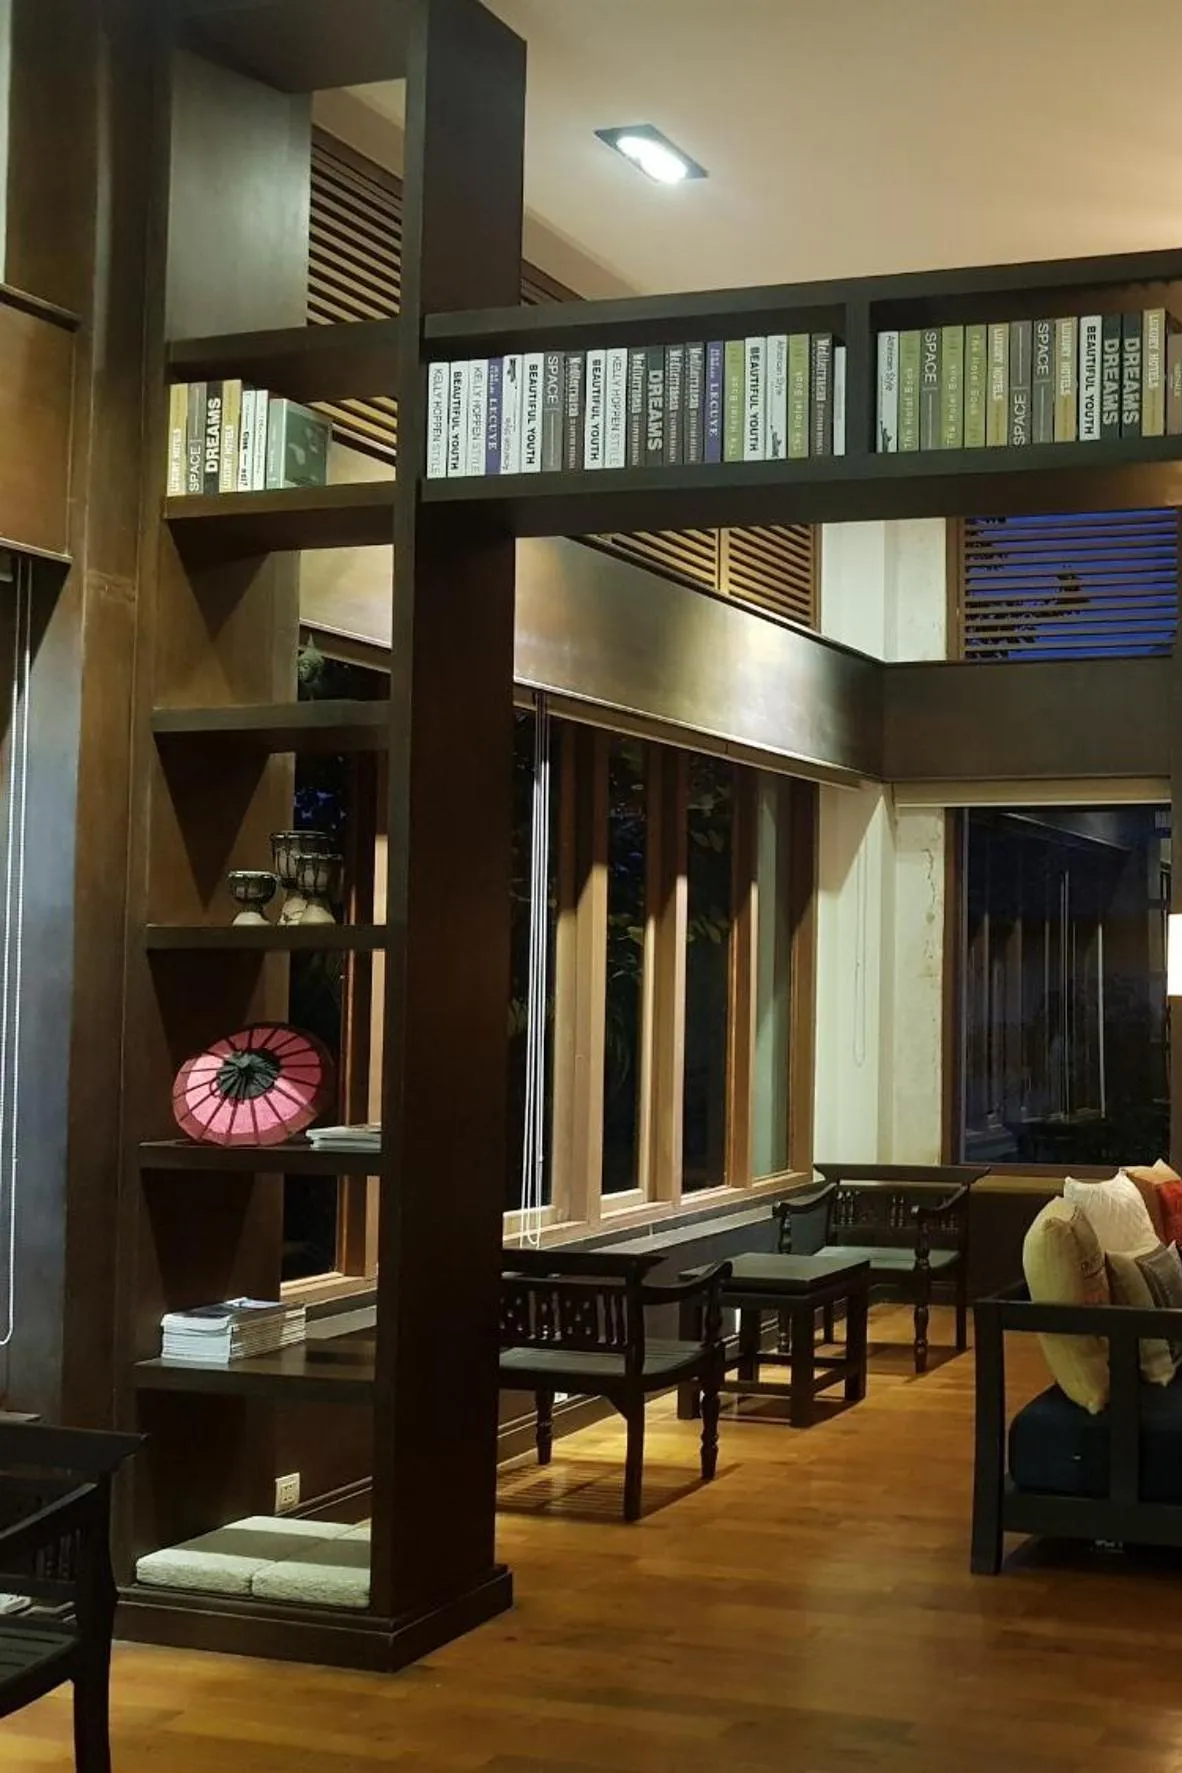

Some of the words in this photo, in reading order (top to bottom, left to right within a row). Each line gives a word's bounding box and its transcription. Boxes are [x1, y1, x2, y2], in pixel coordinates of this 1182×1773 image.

[613, 356, 622, 387] KELLY
[924, 332, 936, 383] SPACE
[1037, 323, 1048, 375] SPACE
[1086, 326, 1096, 391] BEAUTIFUL
[433, 369, 442, 398] KELLY
[452, 372, 462, 430] BEAUTIFUL
[473, 367, 482, 397] KELLY
[528, 364, 538, 424] BEAUTIFUL
[548, 356, 558, 404] SPACE
[591, 359, 601, 419] BEAUTIFUL
[750, 347, 760, 409] BEAUTIFUL
[1103, 338, 1119, 425] DREAMS
[1123, 337, 1140, 425] DREAMS
[433, 401, 442, 441] HOPPEN
[472, 400, 481, 440] HOPPEN
[488, 398, 497, 450] LECUYE
[611, 389, 621, 430] HOPPEN
[648, 370, 663, 450] DREAMS
[710, 383, 718, 437] LECUYE
[750, 412, 758, 451] YOUTH
[1014, 394, 1026, 445] SPACE
[1085, 394, 1094, 434] YOUTH
[206, 398, 221, 473] DREAMS
[431, 443, 441, 473] STYLE
[451, 433, 459, 470] YOUTH
[472, 441, 481, 473] STYLE
[526, 427, 536, 464] YOUTH
[591, 423, 599, 460] YOUTH
[610, 433, 620, 465] STYLE
[189, 446, 201, 491] SPACE
